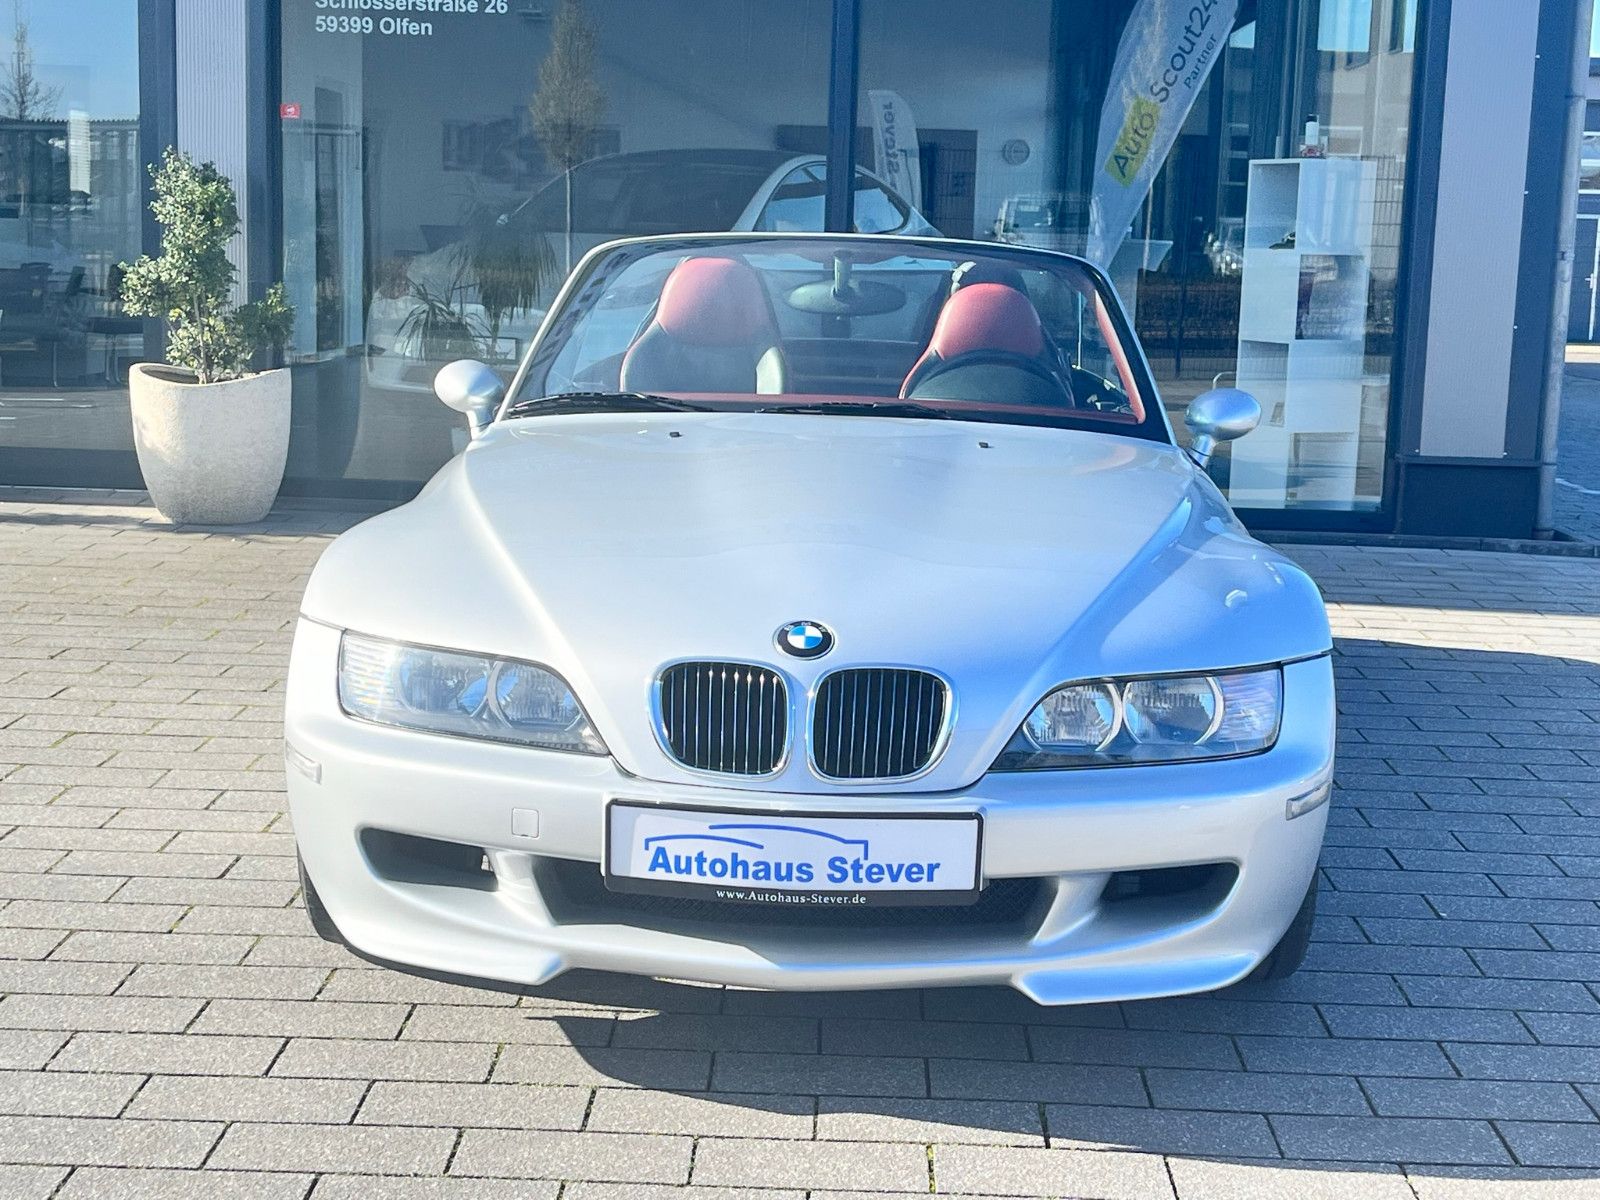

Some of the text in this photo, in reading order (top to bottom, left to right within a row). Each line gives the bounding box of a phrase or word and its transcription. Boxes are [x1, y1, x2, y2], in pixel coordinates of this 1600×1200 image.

[484, 0, 508, 14] 26
[315, 15, 433, 35] 59399 Olfen
[1183, 34, 1217, 89] Partner
[1113, 112, 1154, 178] Auto
[648, 846, 941, 884] Autohaus Stever
[716, 889, 867, 905] www.Autohaus-Stever.de
